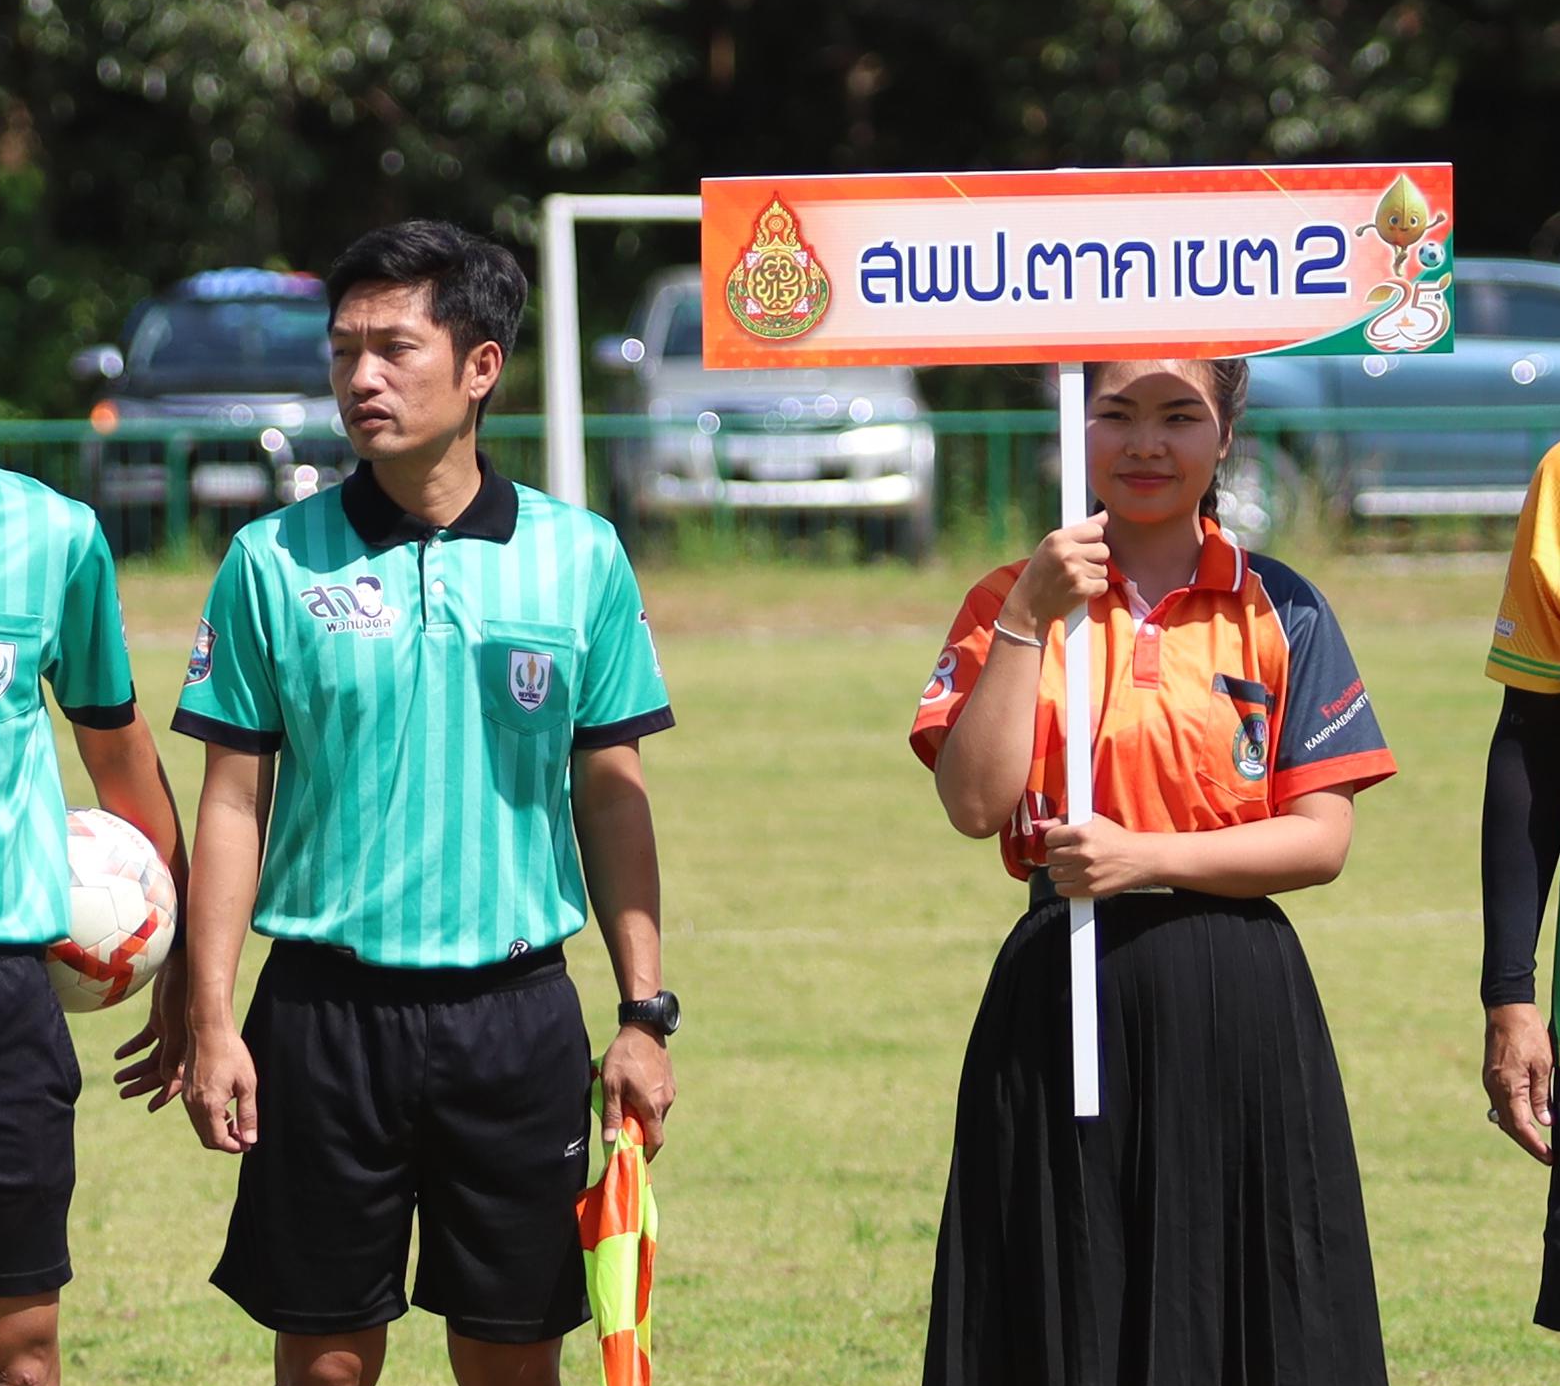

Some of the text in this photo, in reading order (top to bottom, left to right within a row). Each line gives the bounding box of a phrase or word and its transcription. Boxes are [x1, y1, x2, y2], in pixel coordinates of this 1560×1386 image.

[860, 230, 1155, 305] สพป.ตาก
[1173, 235, 1279, 297] เขต
[1294, 224, 1349, 295] 2
